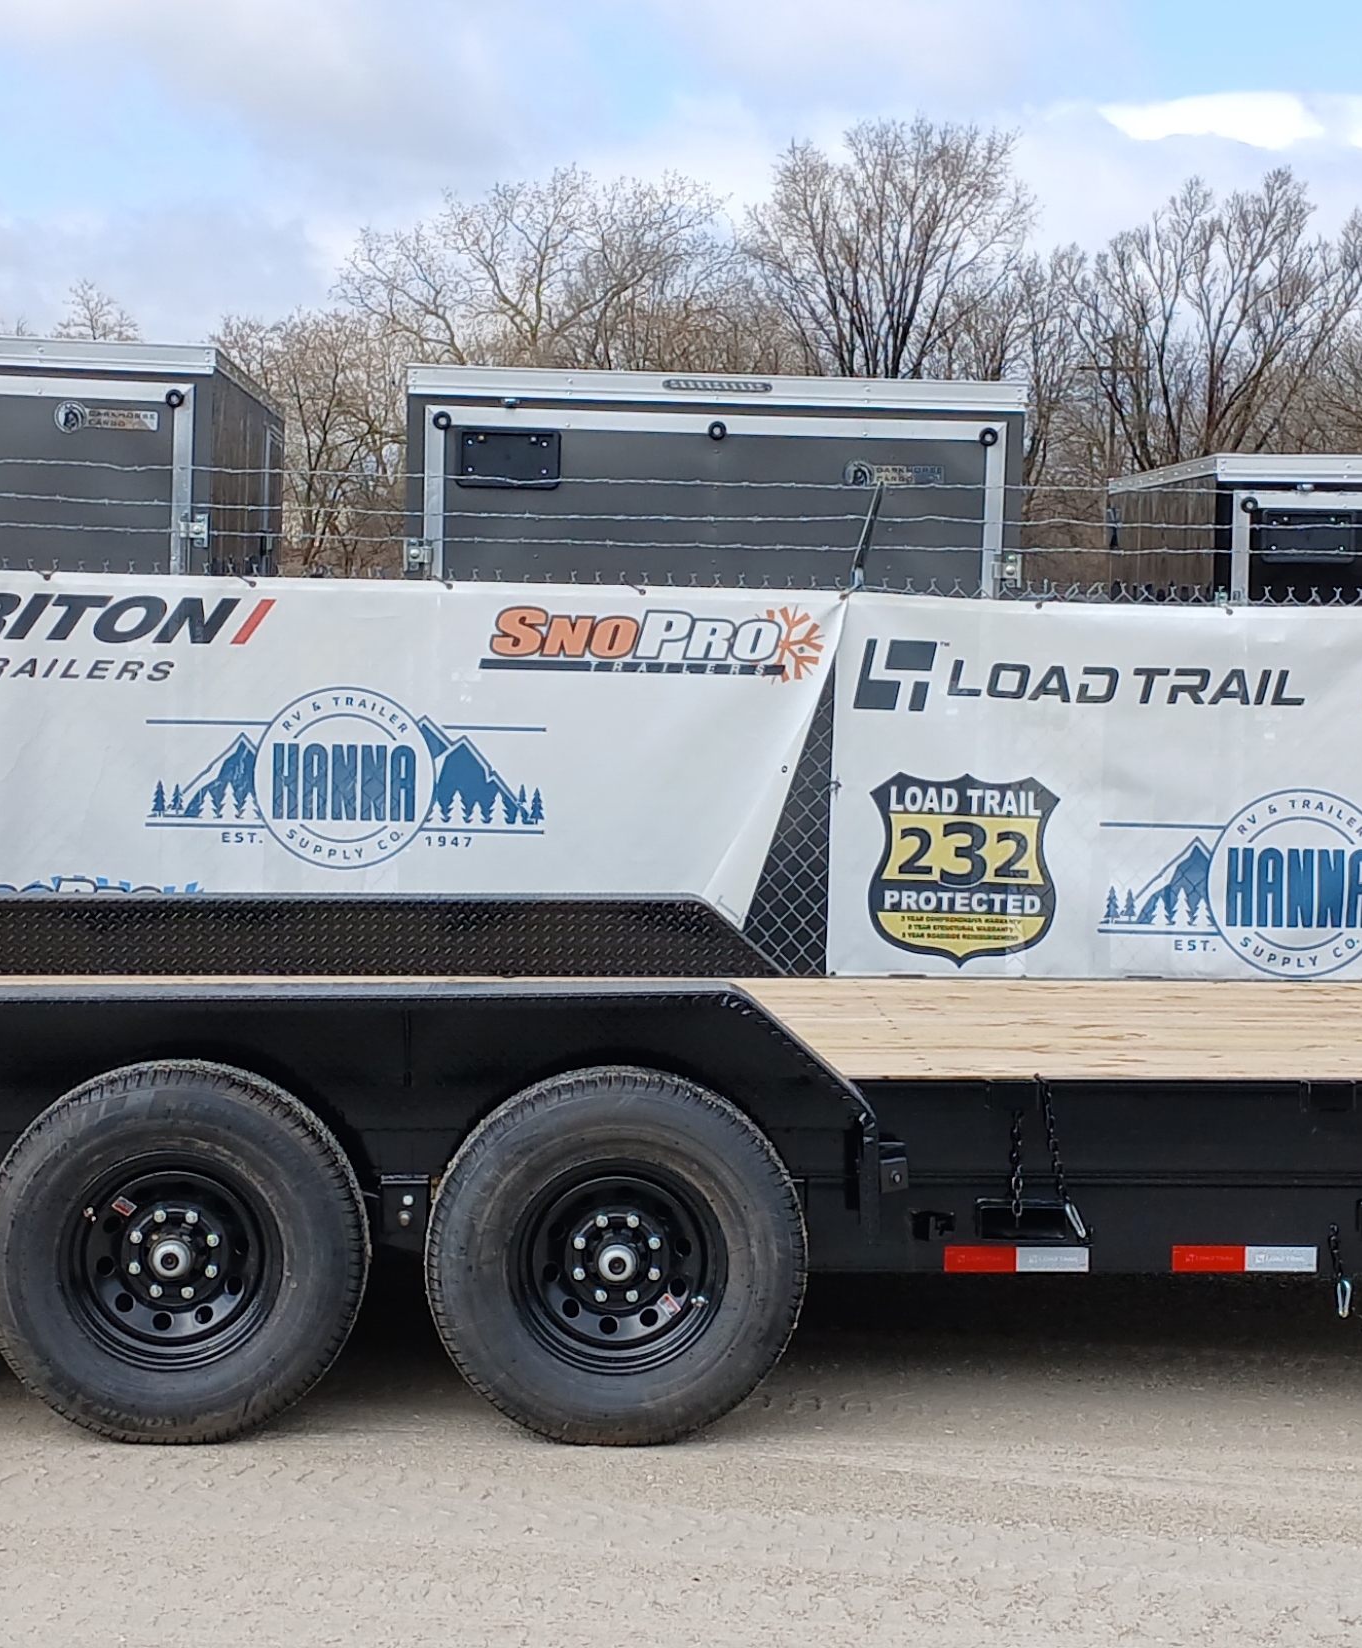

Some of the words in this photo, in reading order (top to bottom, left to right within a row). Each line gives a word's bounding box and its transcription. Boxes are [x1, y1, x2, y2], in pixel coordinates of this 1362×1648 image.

[590, 661, 765, 676] TRAILERS
[947, 659, 1119, 703] LOAD
[1133, 668, 1305, 706] TRAIL
[281, 711, 301, 731] RV
[312, 701, 321, 712] &
[333, 696, 409, 734] TRAILER
[272, 742, 416, 822] HANNA
[889, 786, 959, 813] LOAD
[966, 788, 1042, 817] TRAIL
[1237, 814, 1257, 836] RV
[1268, 805, 1278, 815] &
[221, 832, 264, 844] EST.
[287, 829, 363, 860] SUPPLY
[379, 830, 404, 850] CO.
[425, 836, 472, 848] 1947
[898, 821, 1030, 886] 232
[884, 890, 1041, 914] PROTECTED
[1174, 939, 1217, 952] EST.
[1240, 936, 1318, 968] SUPPLY
[1332, 938, 1360, 958] CO.
